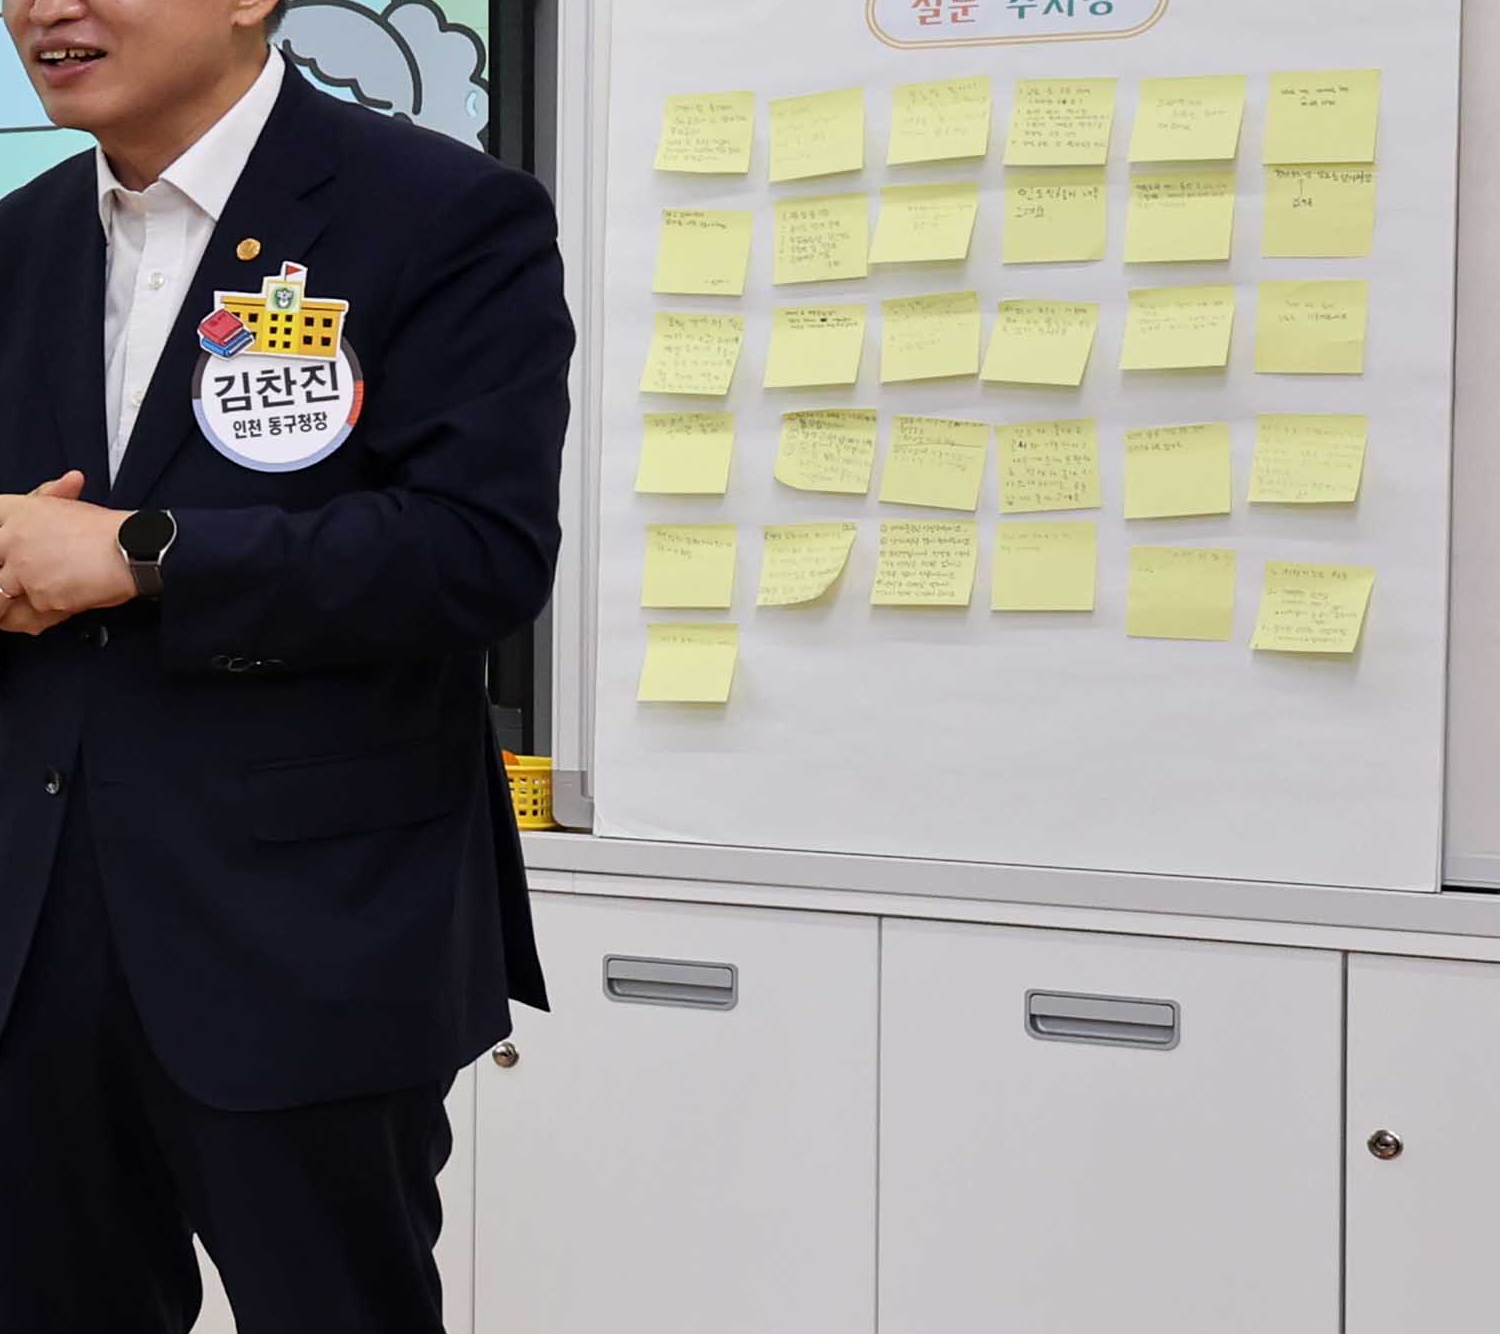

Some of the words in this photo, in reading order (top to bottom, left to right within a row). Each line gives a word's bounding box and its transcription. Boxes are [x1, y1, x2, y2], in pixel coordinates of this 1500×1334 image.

[214, 361, 340, 414] 김찬진
[233, 417, 262, 440] 인천
[268, 411, 328, 436] 동구청장
